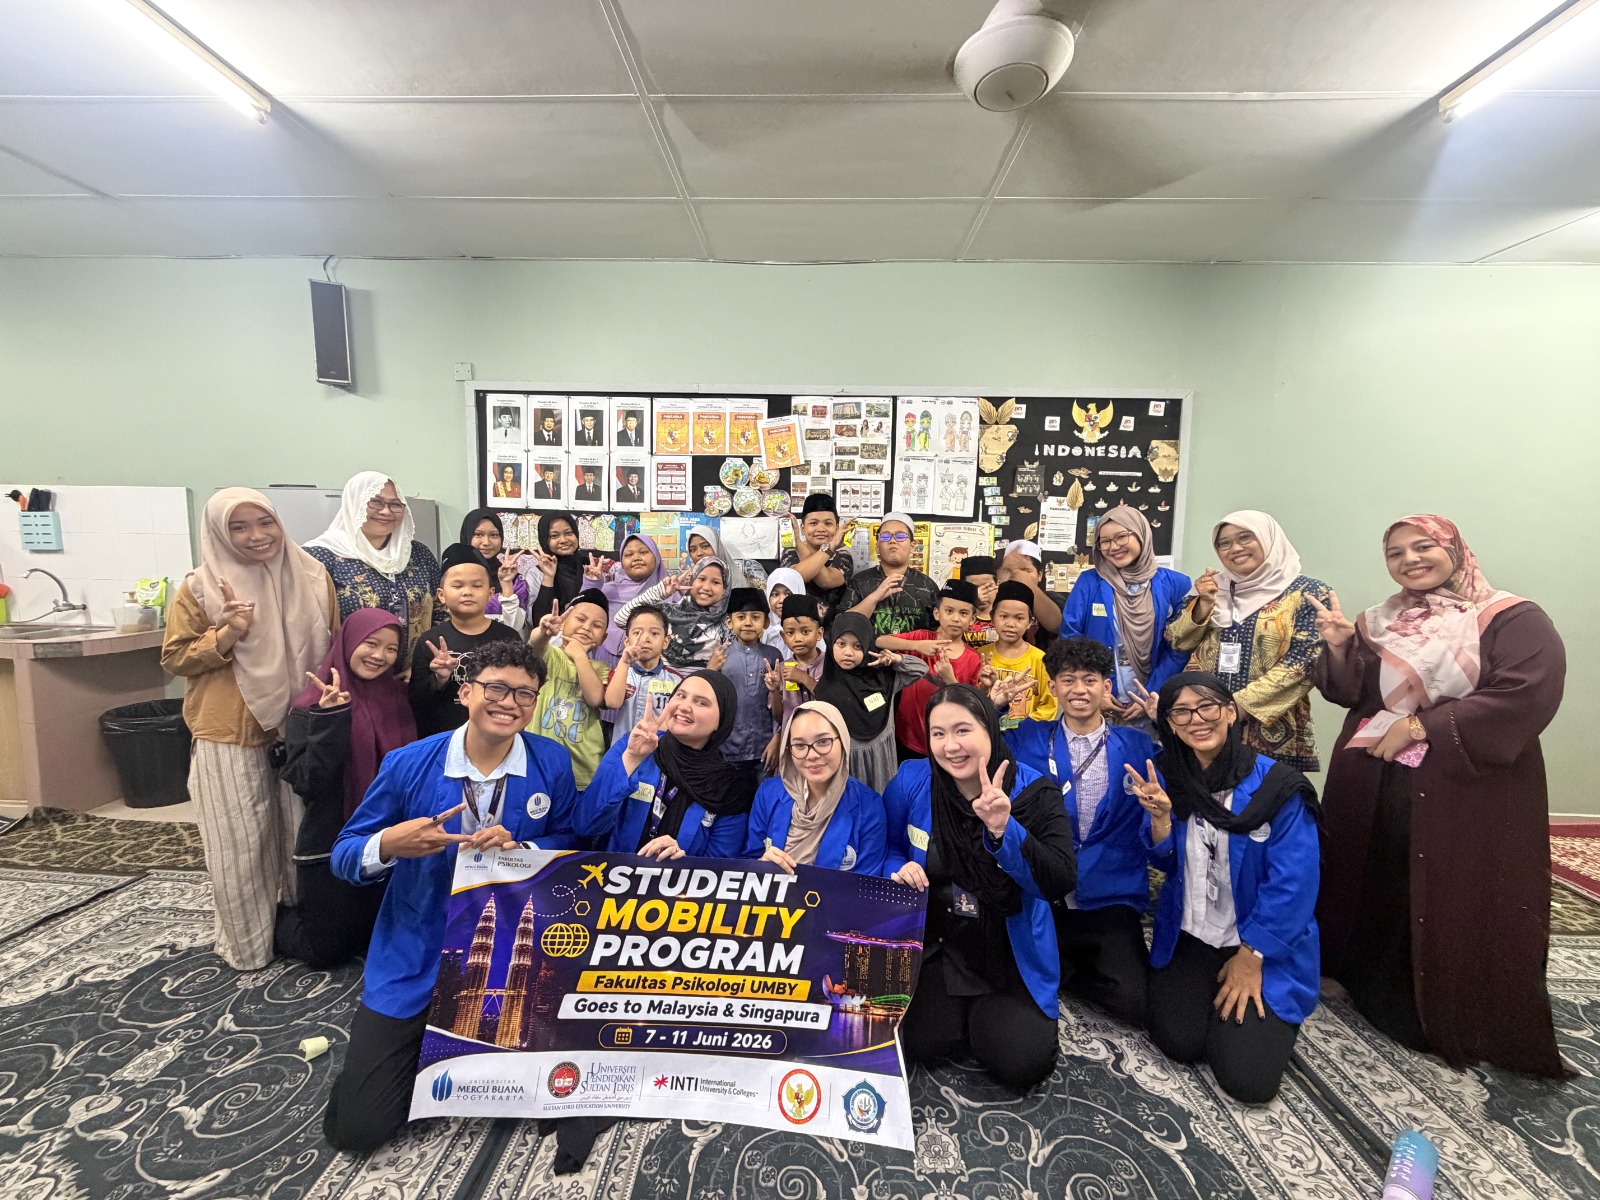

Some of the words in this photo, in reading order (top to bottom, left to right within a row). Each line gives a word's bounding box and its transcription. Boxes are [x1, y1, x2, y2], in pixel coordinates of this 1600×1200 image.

[1034, 444, 1142, 458] INDONESIA
[497, 861, 531, 869] PSIKOLOGI
[603, 866, 798, 903] STUDENT
[596, 898, 806, 938] MOBILITY
[589, 934, 805, 975] PROGRAM
[593, 975, 667, 990] Fakultas
[671, 977, 746, 994] Psikologi
[750, 980, 799, 996] UMBY
[574, 998, 618, 1013] Goes
[624, 1000, 642, 1014] to
[647, 1000, 718, 1019] Malaysia
[722, 1003, 735, 1018] &
[739, 1003, 820, 1024] Singapura
[644, 1029, 657, 1044] 7
[672, 1030, 688, 1045] 11
[692, 1030, 728, 1047] Juni
[728, 1033, 772, 1049] 2026
[591, 1062, 637, 1076] UNIVERSITI
[586, 1071, 636, 1084] PENDIDIKAN
[670, 1075, 699, 1091] INTI
[700, 1078, 736, 1087] International
[457, 1085, 489, 1093] MERCU
[491, 1085, 524, 1093] BUANA
[580, 1080, 611, 1094] SULTAN
[613, 1082, 635, 1094] IDRIS
[699, 1085, 727, 1095] University
